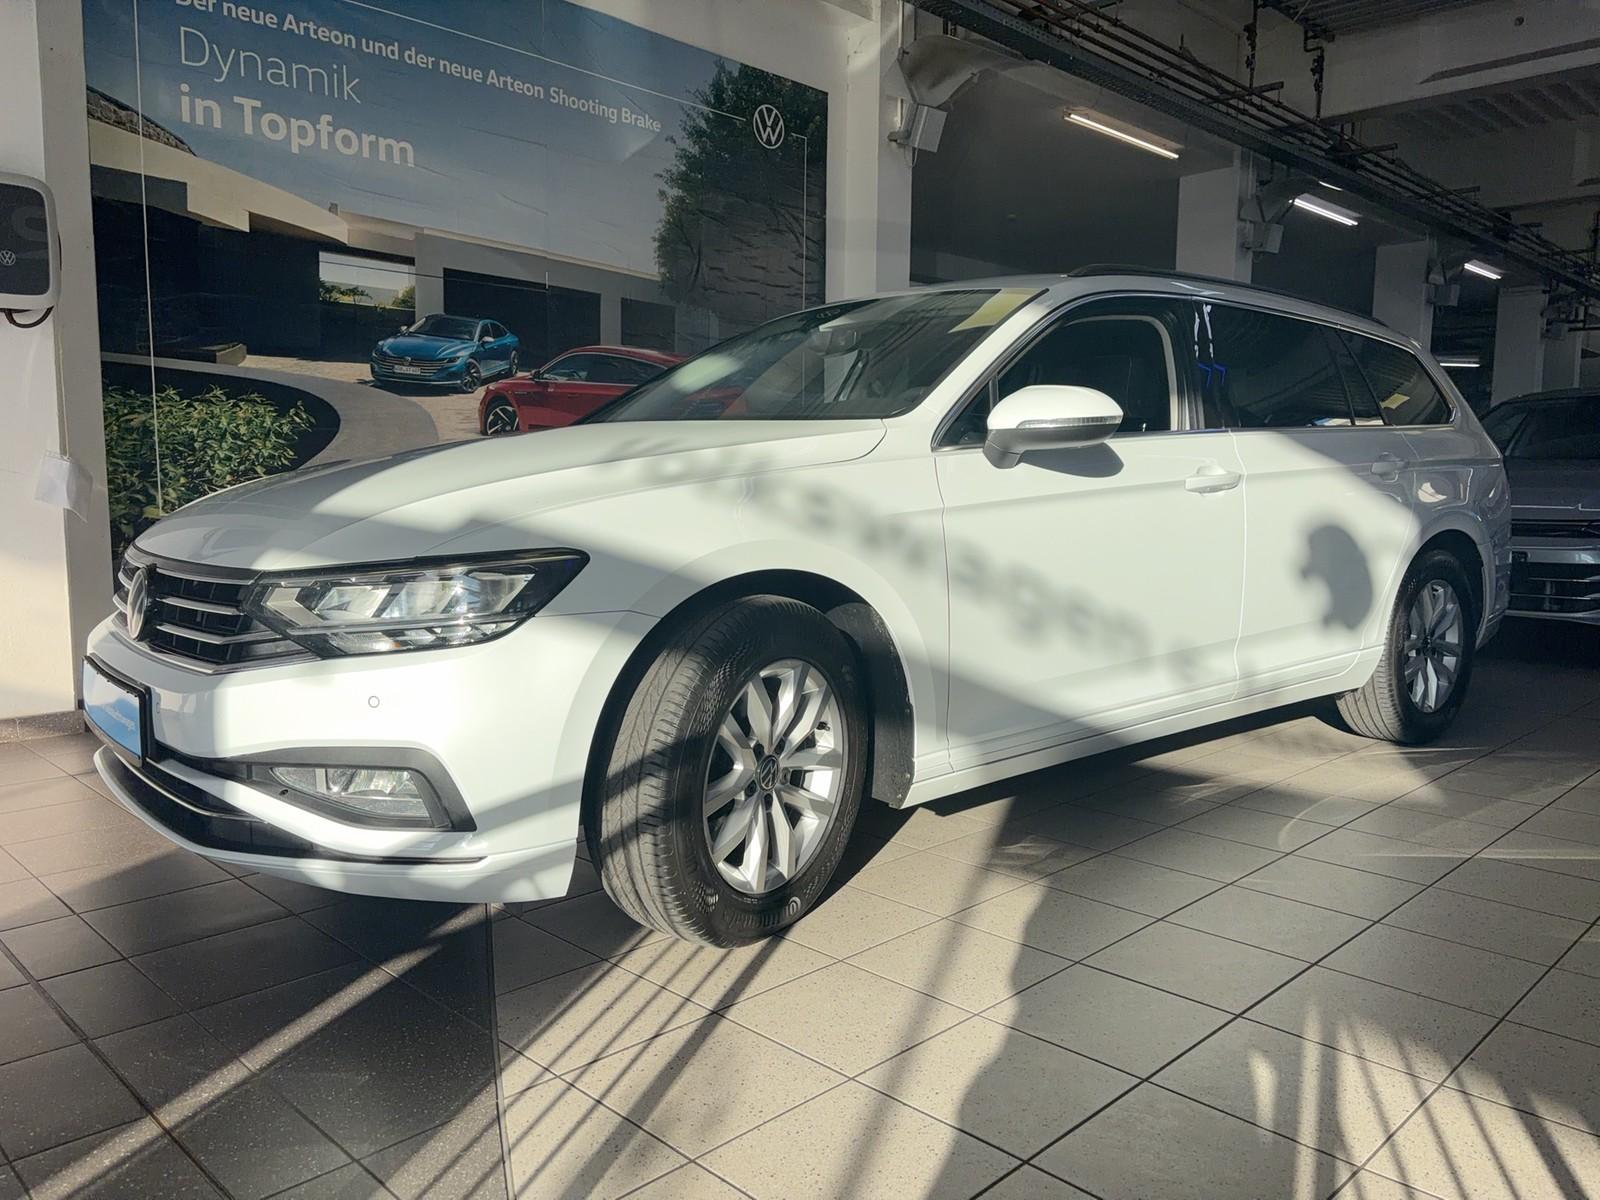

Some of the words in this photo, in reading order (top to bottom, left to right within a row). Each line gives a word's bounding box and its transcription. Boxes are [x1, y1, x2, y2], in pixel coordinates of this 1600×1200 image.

[180, 26, 361, 104] Dynamik
[222, 1, 278, 29] neue
[282, 13, 357, 49] Arteon
[362, 38, 399, 61] und
[404, 47, 436, 70] der
[439, 58, 484, 83] neue
[486, 69, 545, 100] Arteon
[550, 87, 618, 124] Shooting
[621, 107, 662, 132] Brake
[179, 83, 222, 129] in
[233, 95, 415, 168] Topform
